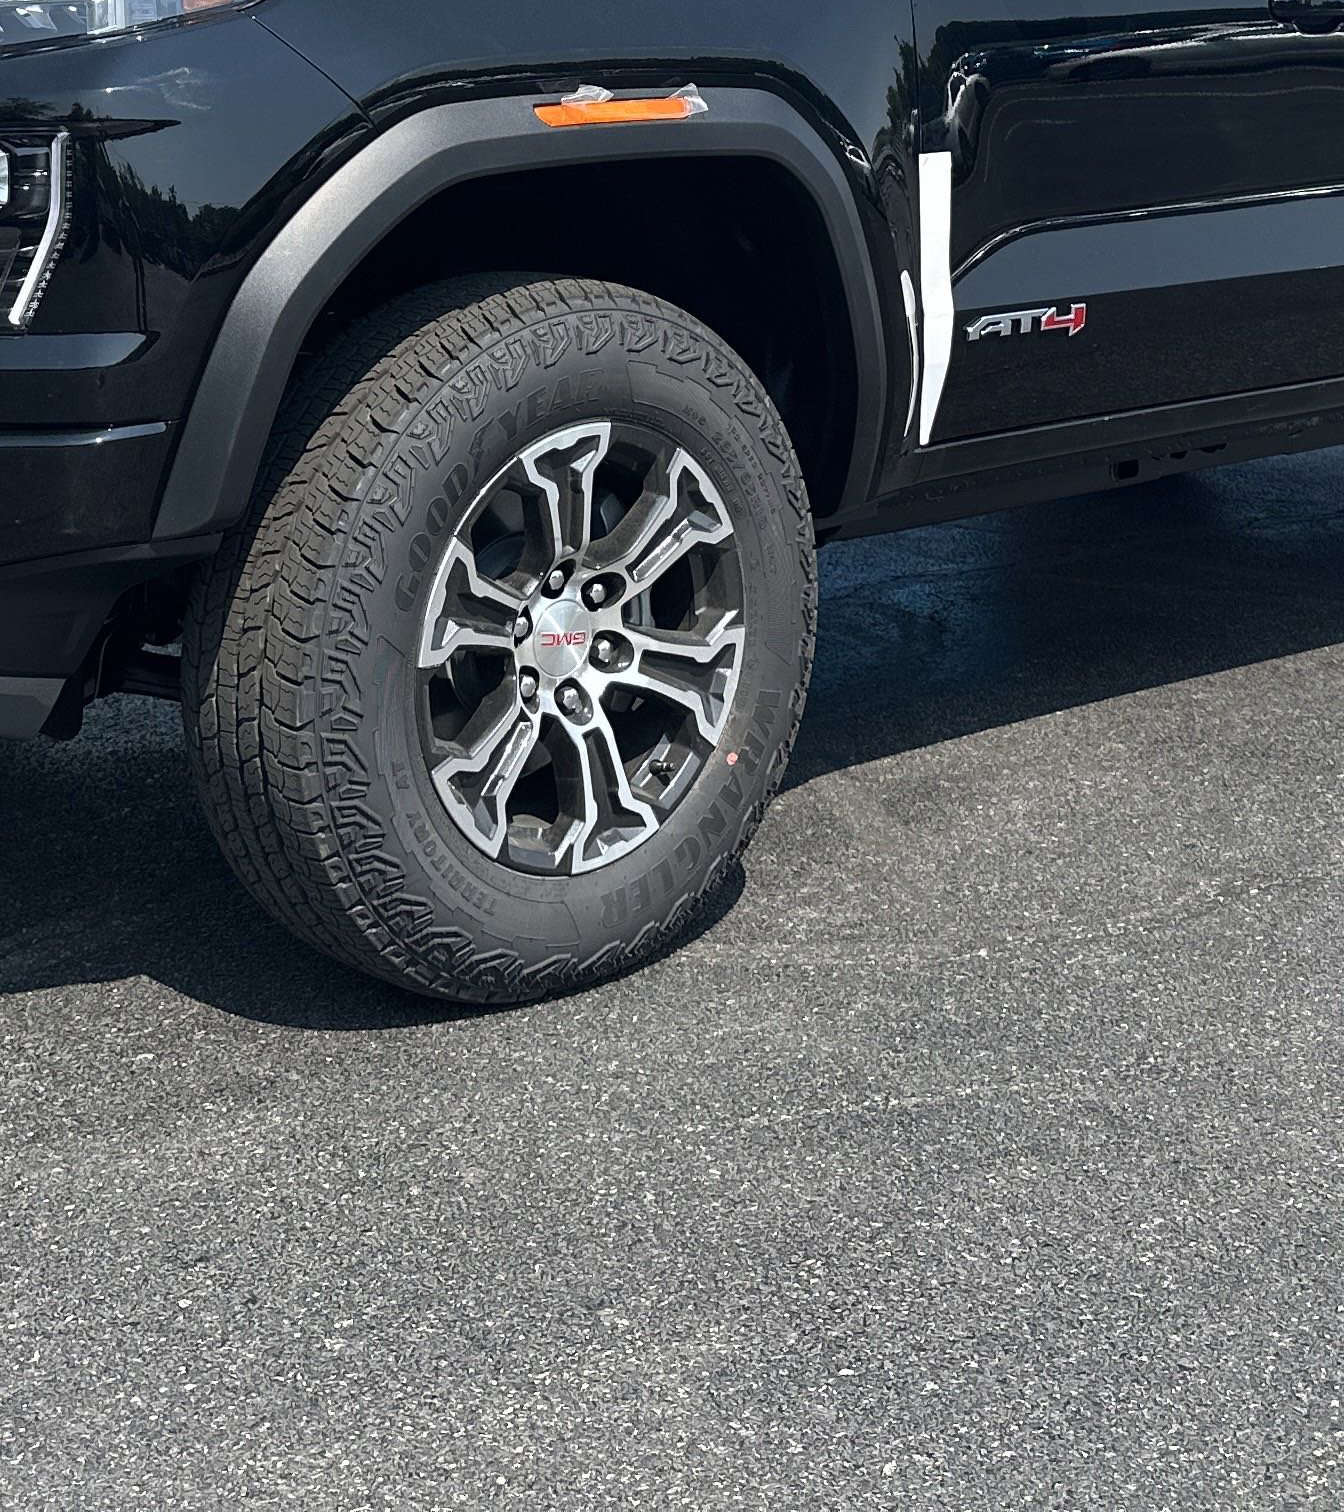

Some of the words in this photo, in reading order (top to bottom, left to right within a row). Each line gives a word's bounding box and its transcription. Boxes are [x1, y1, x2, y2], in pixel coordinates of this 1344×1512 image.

[965, 303, 1086, 341] AT4
[540, 631, 588, 648] GMC
[600, 688, 780, 925] WRANGLER
[410, 806, 498, 916] TERRITORY
